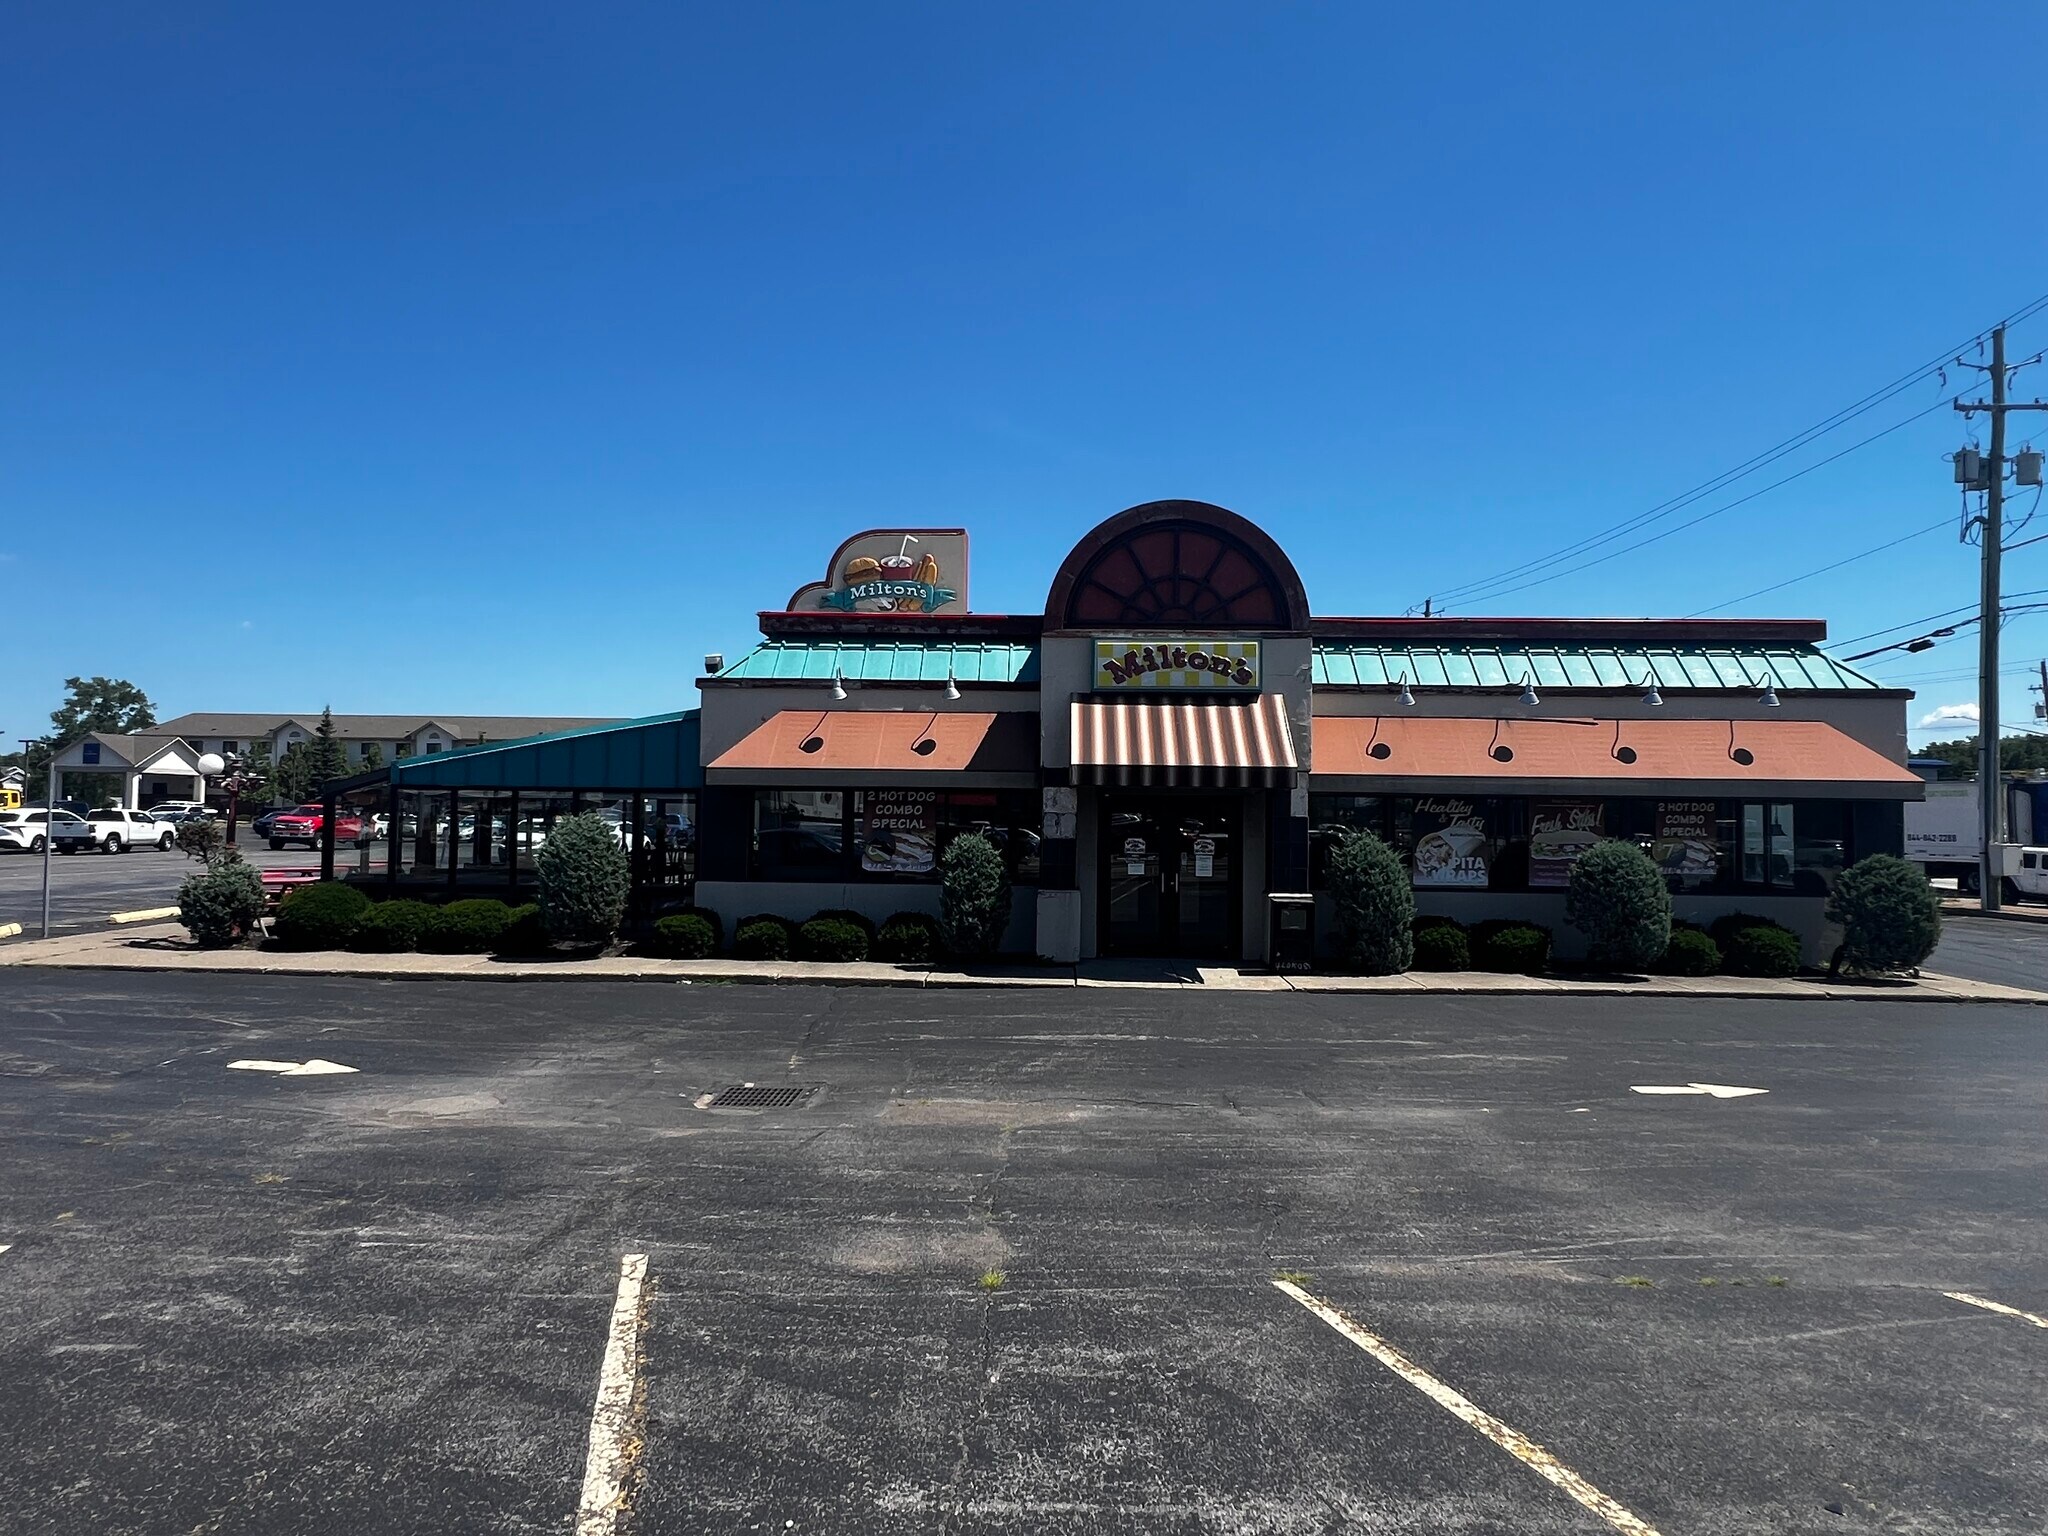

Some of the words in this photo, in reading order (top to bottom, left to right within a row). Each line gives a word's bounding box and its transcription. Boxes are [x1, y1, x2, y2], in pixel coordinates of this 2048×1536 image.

[850, 582, 927, 600] Milton's
[1102, 643, 1253, 685] Milton's
[867, 791, 876, 800] 2
[879, 791, 905, 801] HOT
[907, 791, 936, 801] DOG
[875, 804, 923, 815] COMBO
[1414, 797, 1473, 816] Healthy
[1657, 802, 1666, 812] 2
[1668, 802, 1690, 812] HOT
[1691, 802, 1715, 812] DOG
[871, 818, 926, 829] SPECIAL
[1449, 814, 1485, 831] Tasty
[1665, 814, 1706, 825] COMBO
[1662, 827, 1708, 837] SPECIAL
[1452, 857, 1486, 869] PITA
